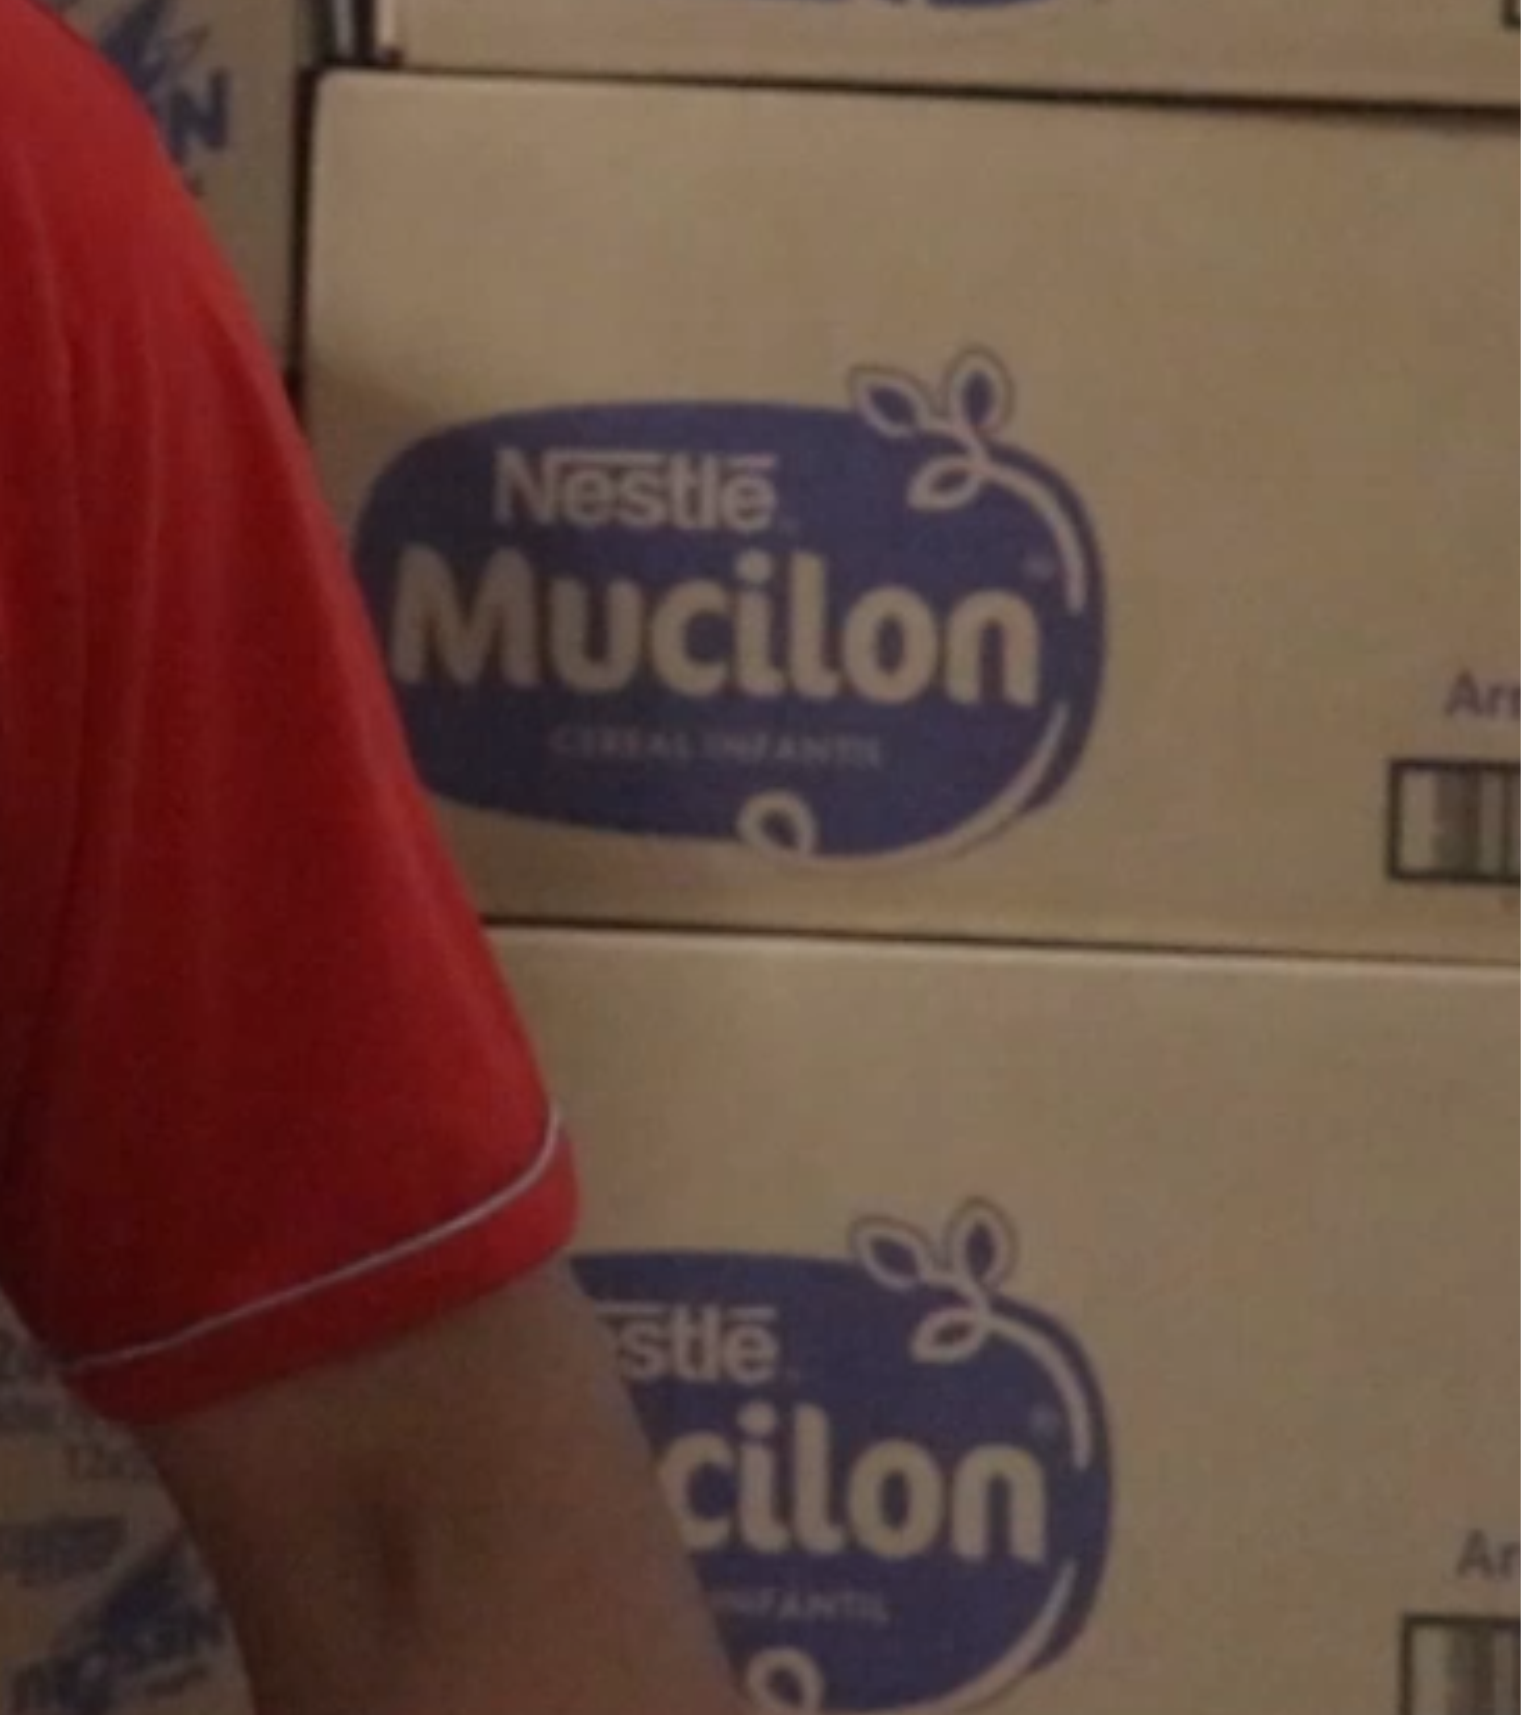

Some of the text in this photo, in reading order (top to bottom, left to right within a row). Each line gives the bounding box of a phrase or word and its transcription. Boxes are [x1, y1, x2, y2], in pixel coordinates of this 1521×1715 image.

[496, 450, 778, 532] Nestlé
[390, 546, 1038, 707] Mucilon
[603, 1305, 778, 1384] stlé
[657, 1402, 1047, 1563] cilon
